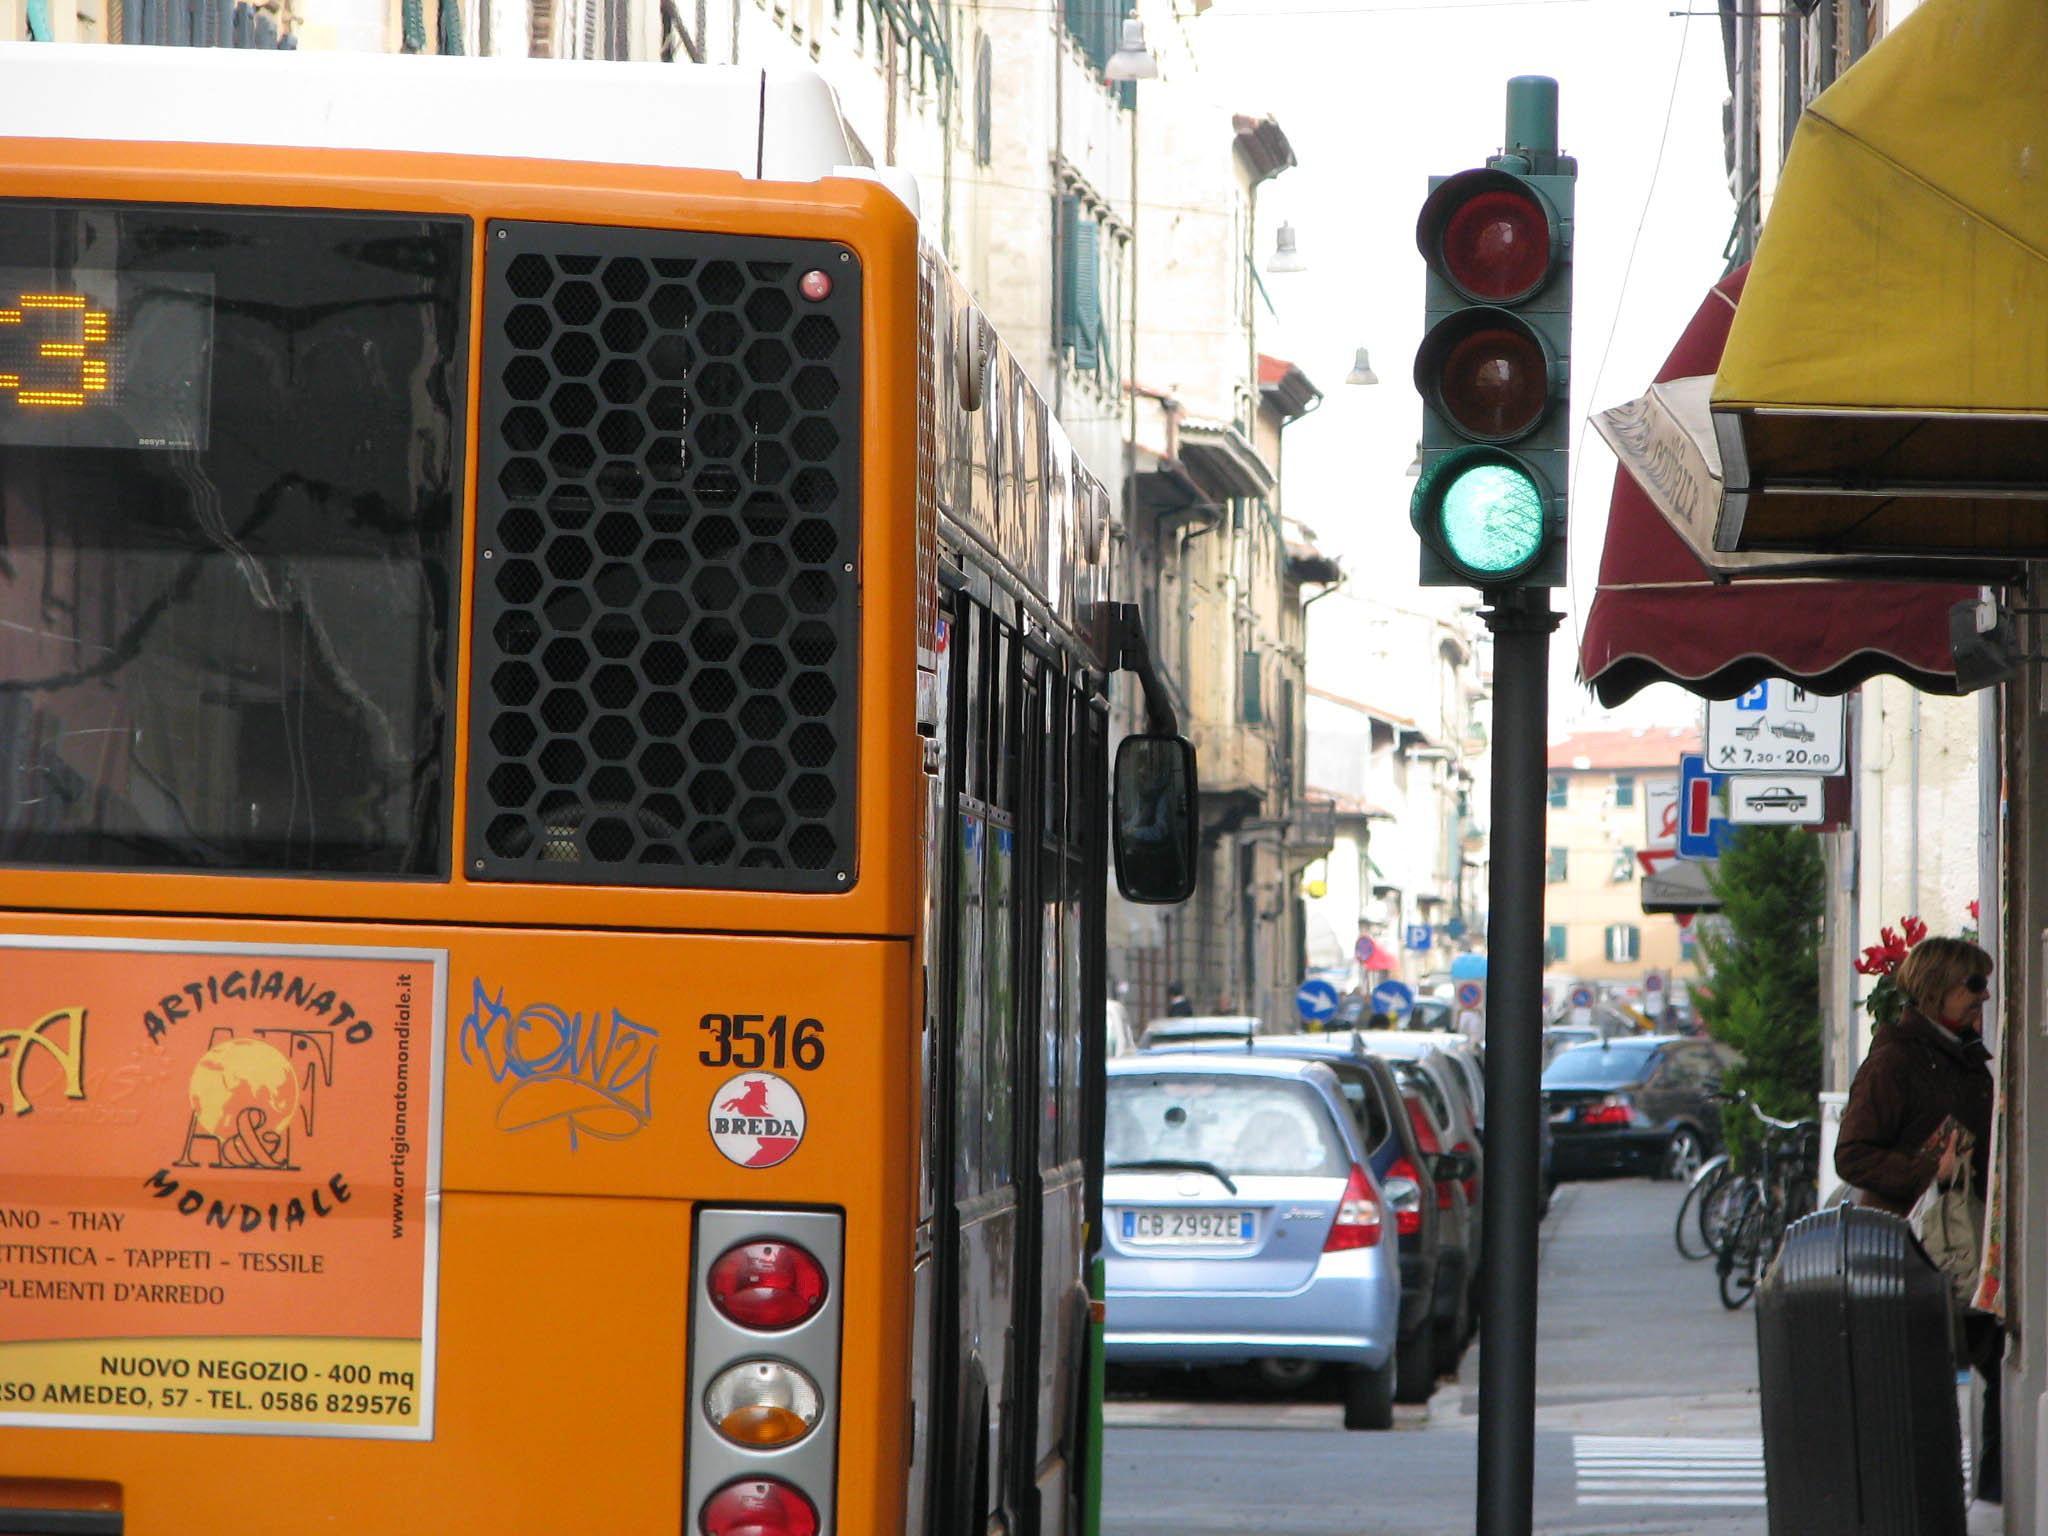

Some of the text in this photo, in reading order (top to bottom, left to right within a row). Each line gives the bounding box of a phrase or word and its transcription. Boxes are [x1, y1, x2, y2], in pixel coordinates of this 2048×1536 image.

[0, 294, 108, 407] 3
[144, 969, 374, 1045] ARTIGIANATO
[698, 1013, 825, 1070] 3516
[389, 973, 413, 1239] www.artigianatomondiale.it
[714, 1117, 799, 1138] BREDA
[143, 1168, 353, 1233] MONDIALE
[68, 1211, 125, 1232] THAY
[1137, 1214, 1238, 1238] CB 299ZE
[0, 1244, 97, 1266] TTISTICA
[124, 1248, 211, 1270] TAPPETI
[239, 1252, 324, 1274] TESSILE
[113, 1283, 225, 1305] D'ARREDO
[101, 1356, 190, 1378] NUOVO
[198, 1359, 308, 1383] NEGOZIO
[328, 1364, 372, 1385] 400
[378, 1371, 414, 1391] mq
[0, 1383, 36, 1402] SO
[42, 1383, 154, 1408] AMEDEO,
[161, 1387, 189, 1408] 57
[207, 1389, 253, 1410] TEL.
[261, 1391, 318, 1412] 0586
[325, 1393, 412, 1416] 829576
